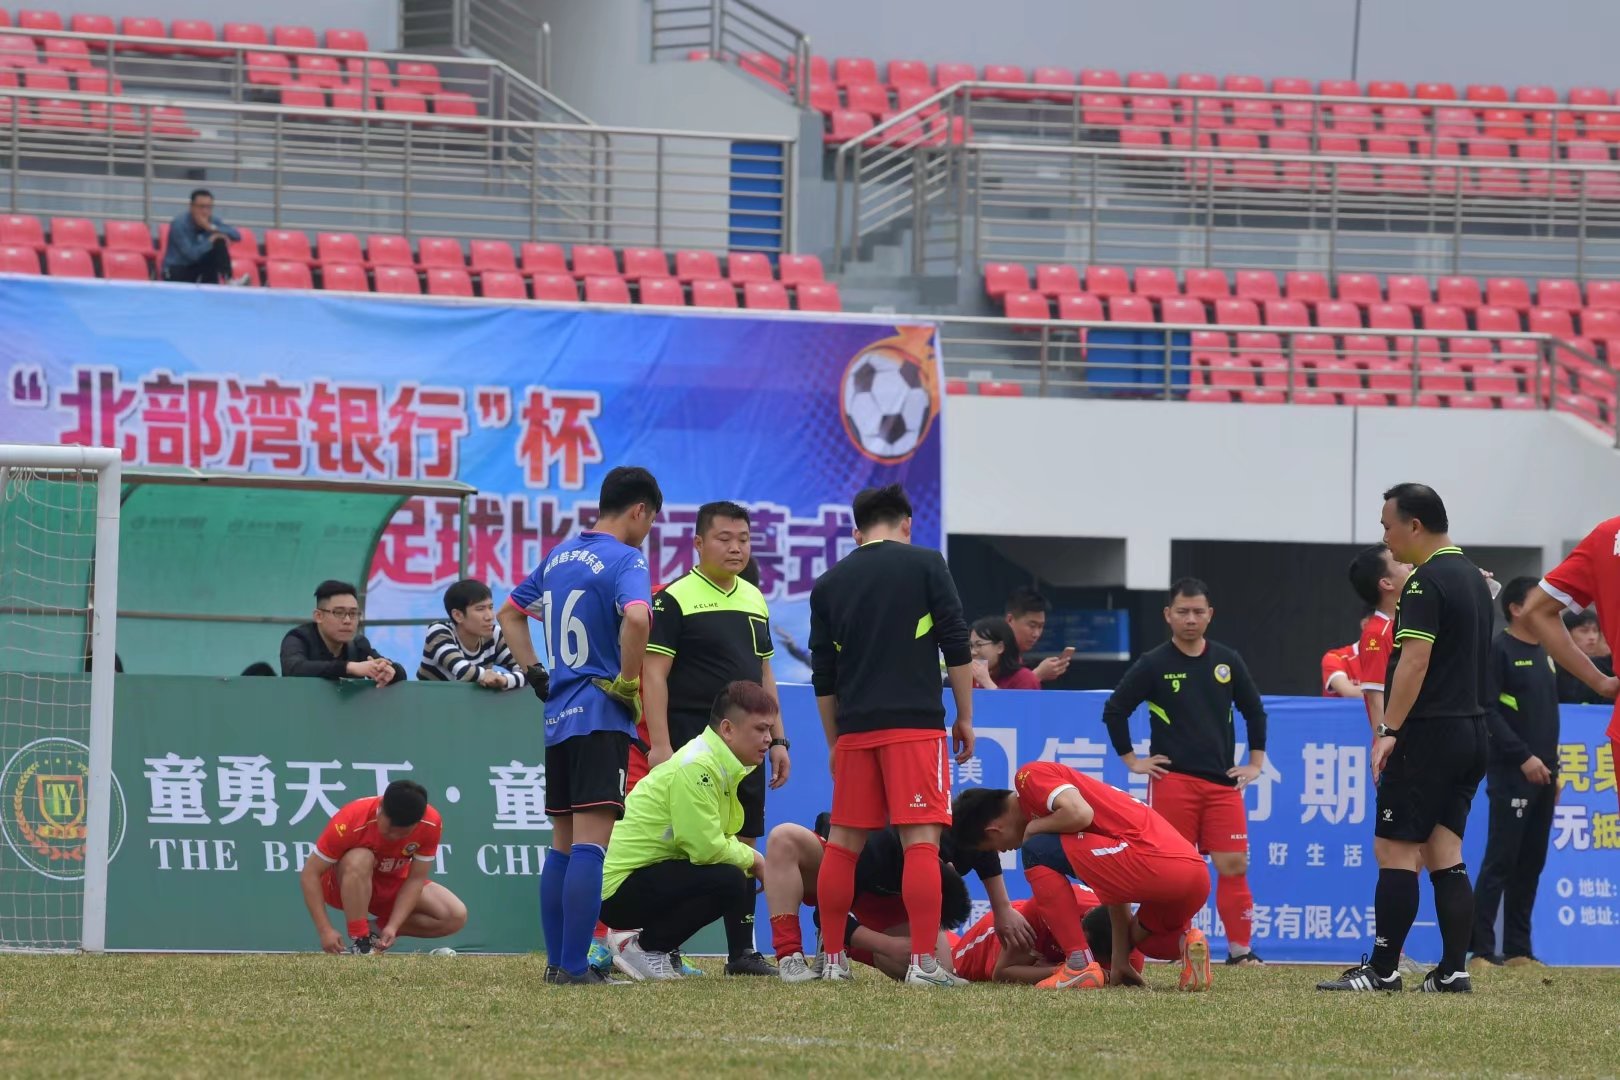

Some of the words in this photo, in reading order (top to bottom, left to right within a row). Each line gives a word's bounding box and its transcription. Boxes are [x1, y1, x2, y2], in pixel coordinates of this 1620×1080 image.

[543, 589, 589, 669] 16
[1172, 680, 1180, 693] 9
[150, 838, 238, 872] THE
